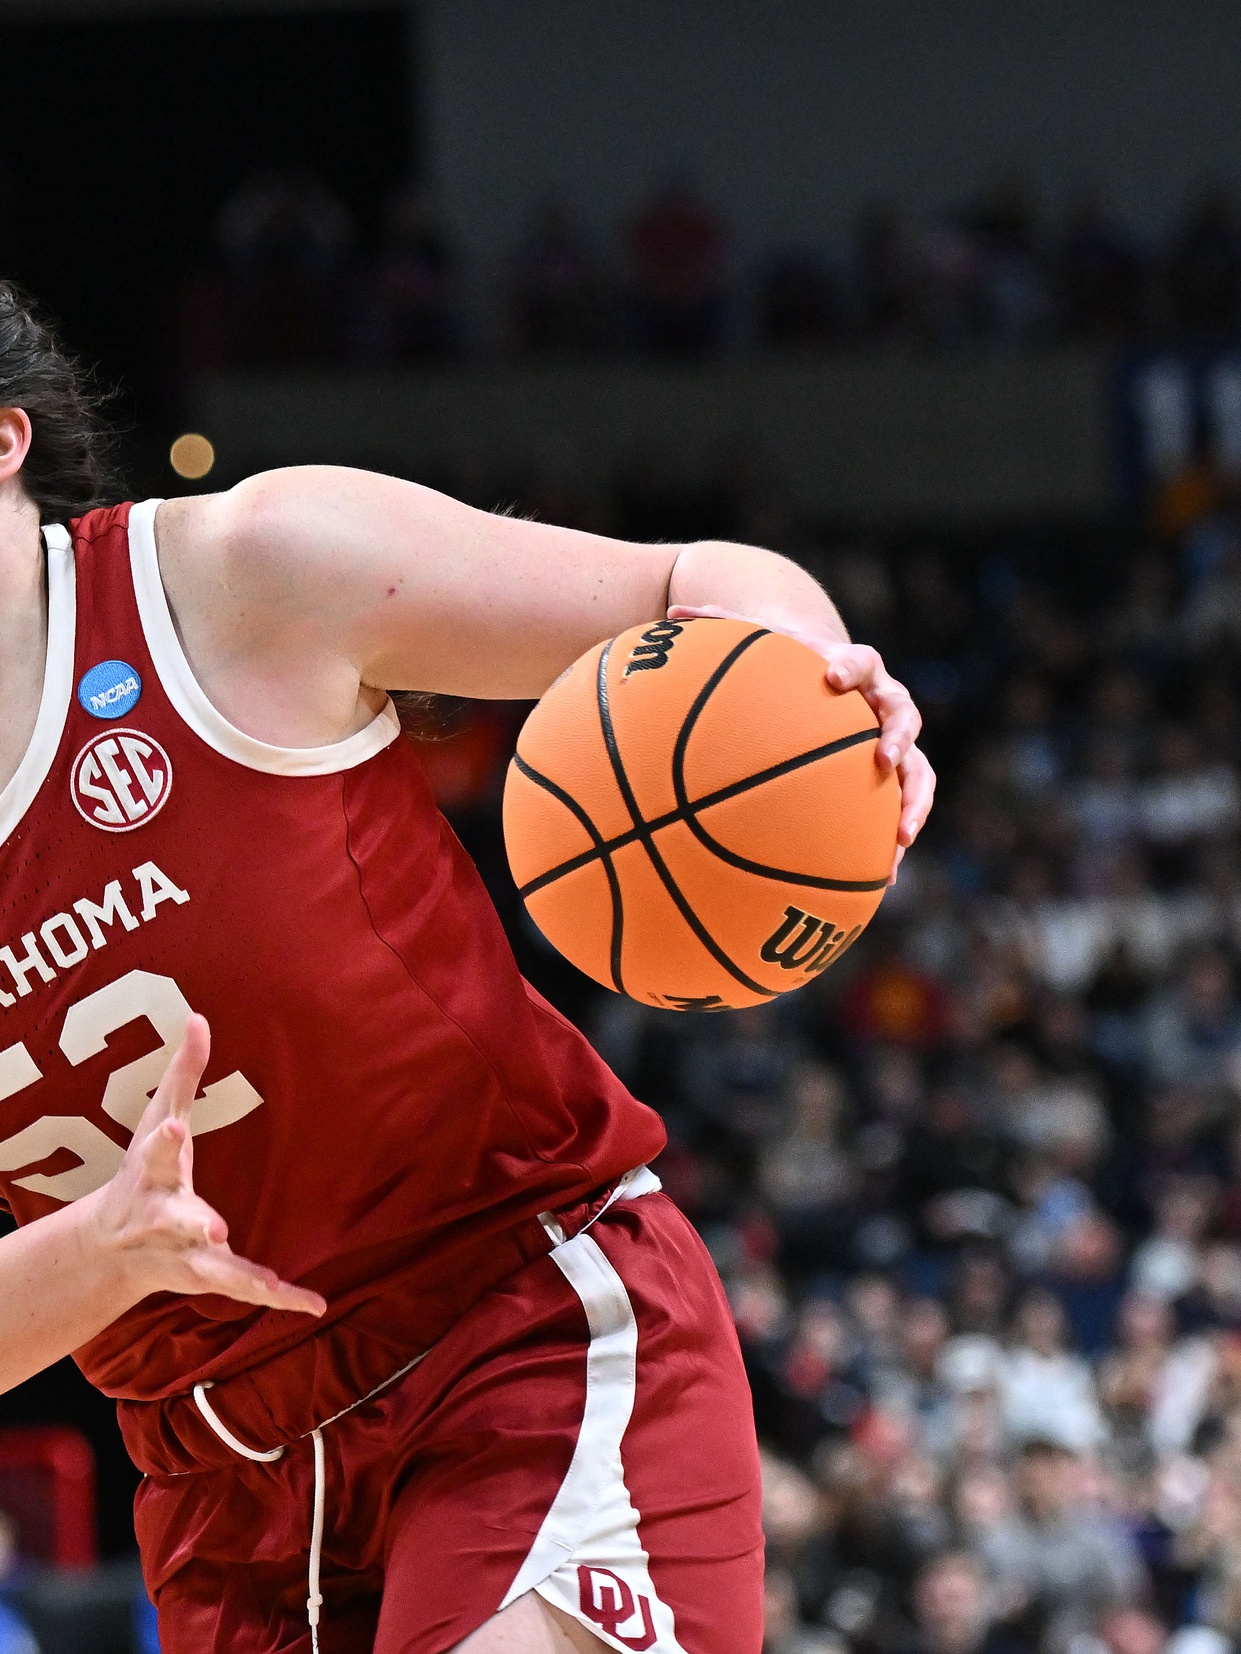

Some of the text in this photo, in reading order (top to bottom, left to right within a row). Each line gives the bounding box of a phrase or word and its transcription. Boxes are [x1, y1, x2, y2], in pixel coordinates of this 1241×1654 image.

[625, 618, 694, 676] on
[90, 677, 140, 711] NCAA
[78, 736, 164, 823] SEC
[577, 1564, 658, 1652] OU
